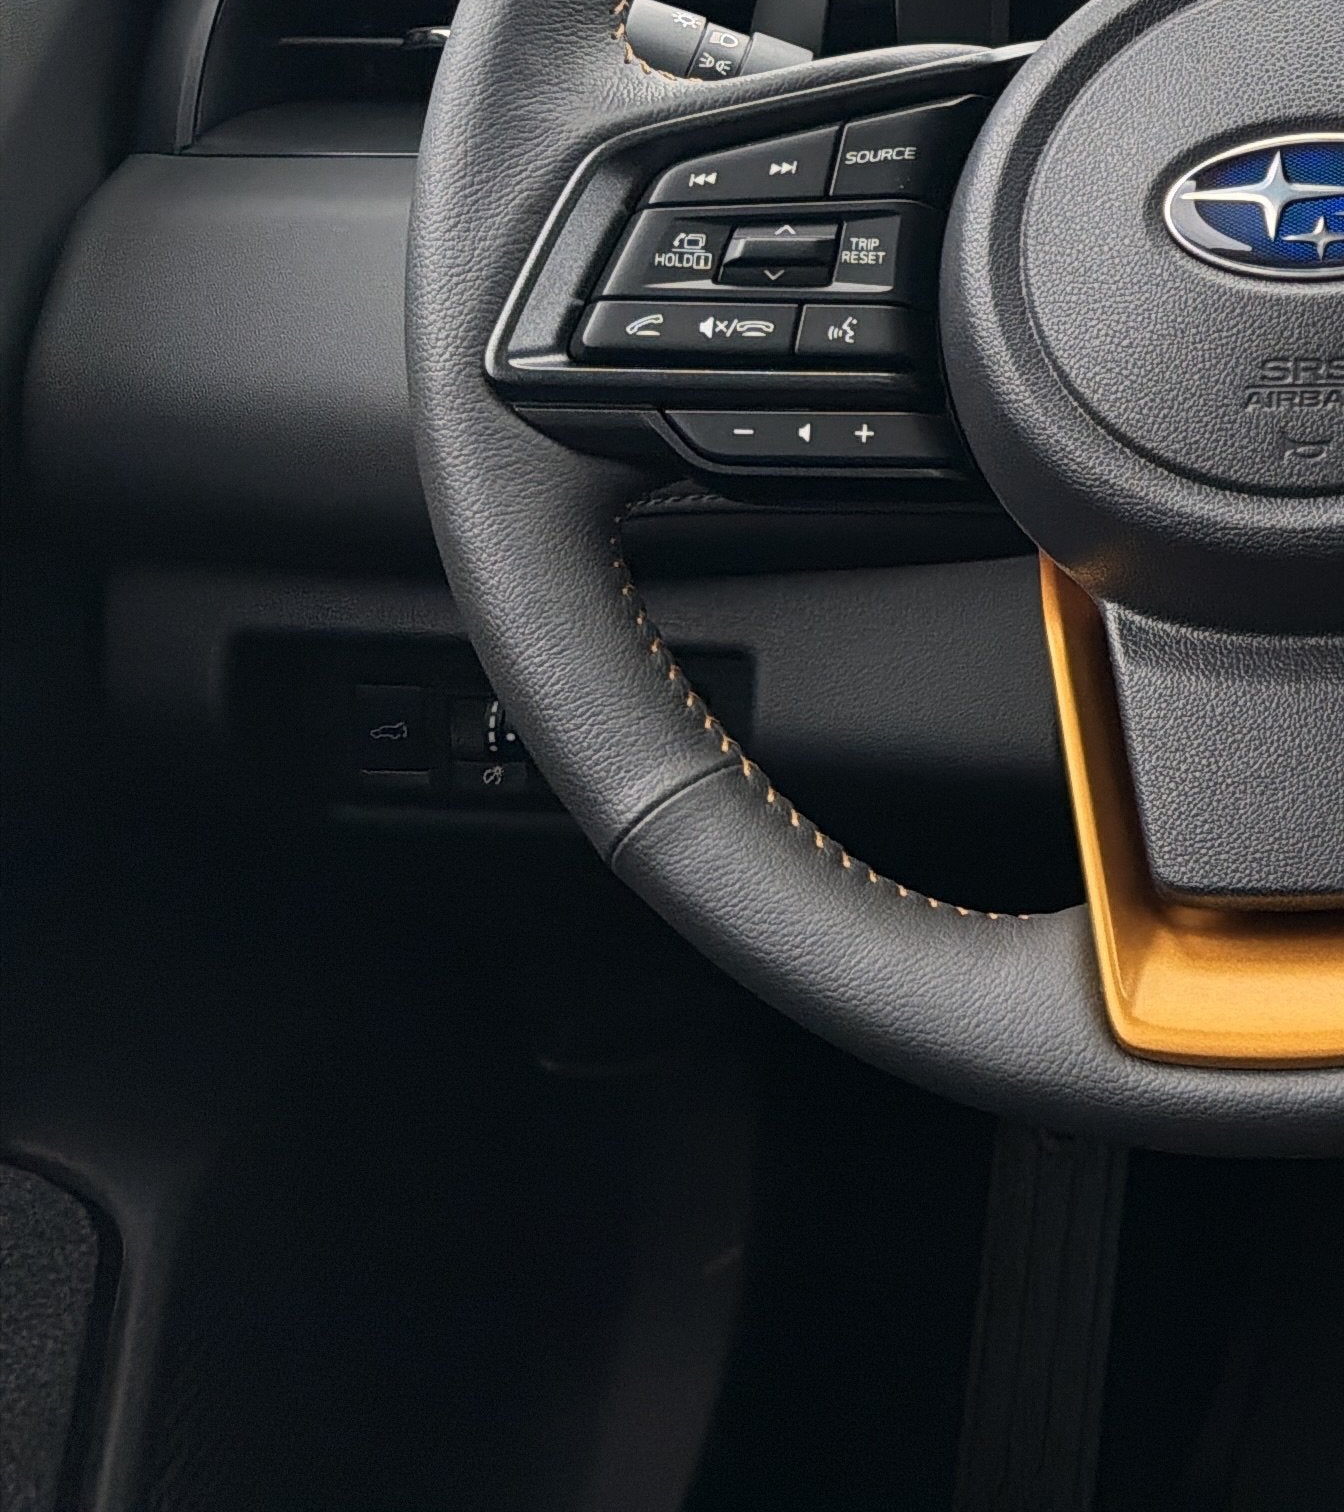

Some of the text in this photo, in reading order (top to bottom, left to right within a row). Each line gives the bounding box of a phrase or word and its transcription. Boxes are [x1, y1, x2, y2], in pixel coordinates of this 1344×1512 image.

[844, 146, 918, 165] SOURCE
[850, 237, 880, 250] TRIP
[841, 250, 887, 265] RESET
